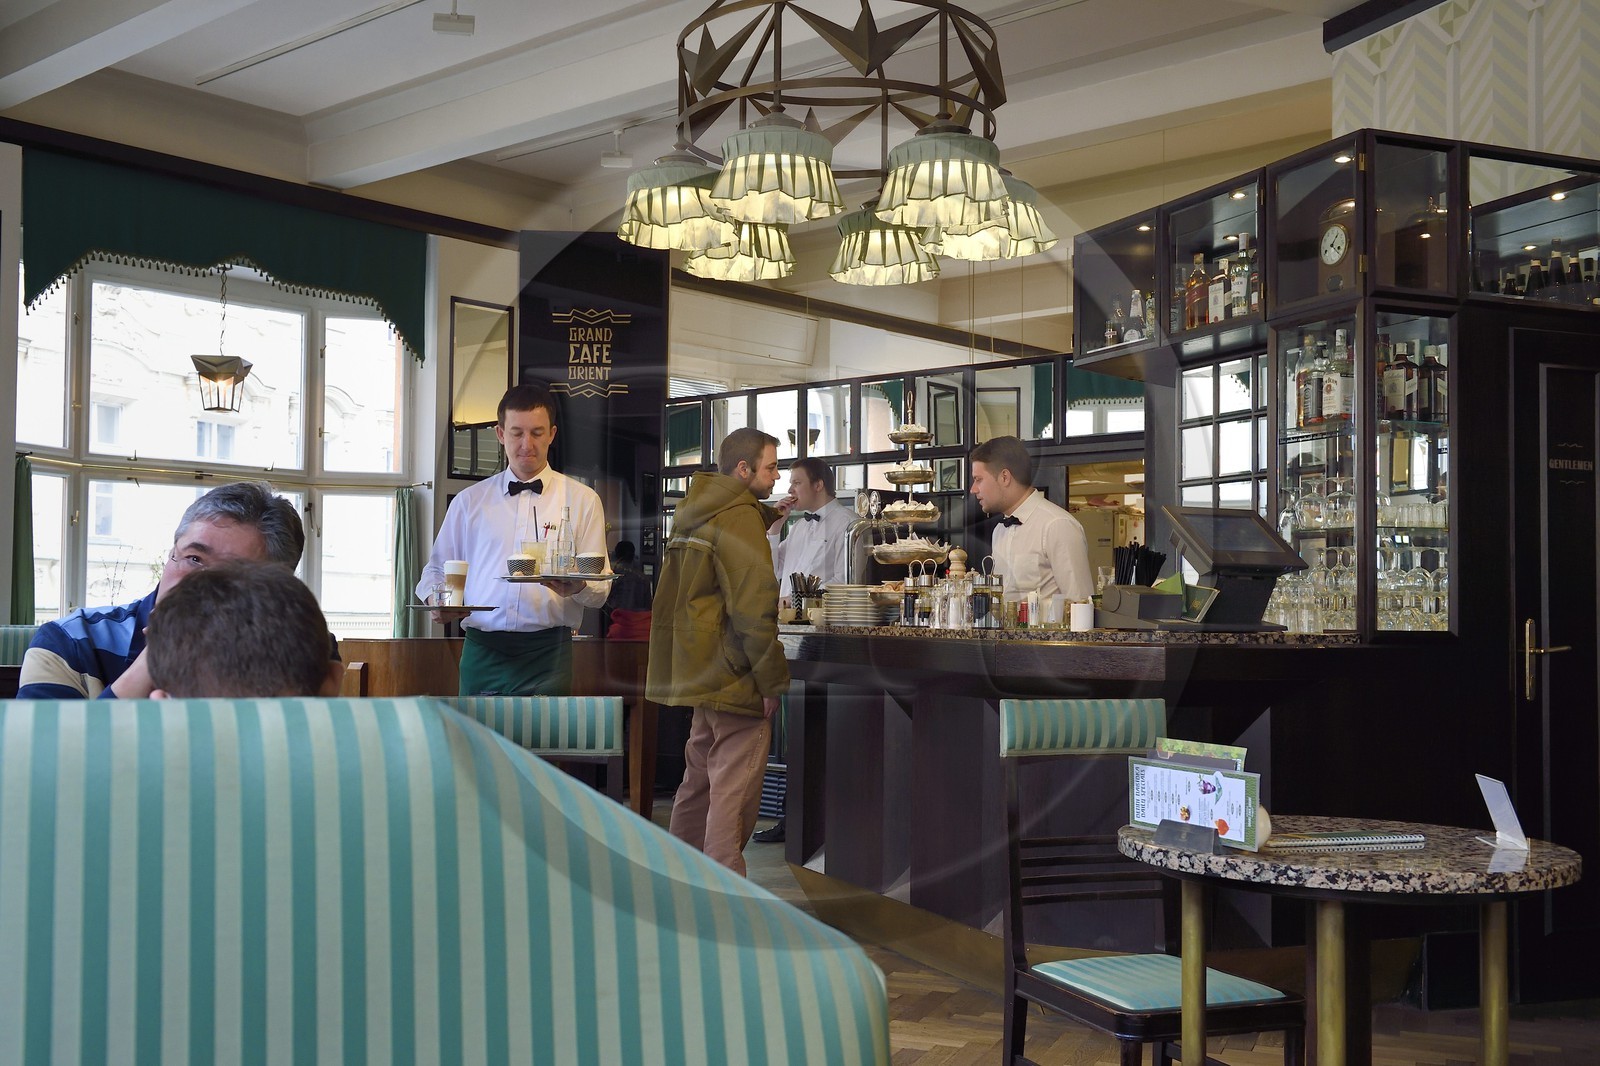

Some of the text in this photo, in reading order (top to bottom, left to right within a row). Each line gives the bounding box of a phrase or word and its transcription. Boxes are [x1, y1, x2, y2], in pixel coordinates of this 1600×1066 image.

[569, 327, 613, 342] GRAND
[569, 344, 612, 364] CAFE
[568, 366, 612, 381] ORIENT
[1548, 458, 1593, 471] GENTLEMEN
